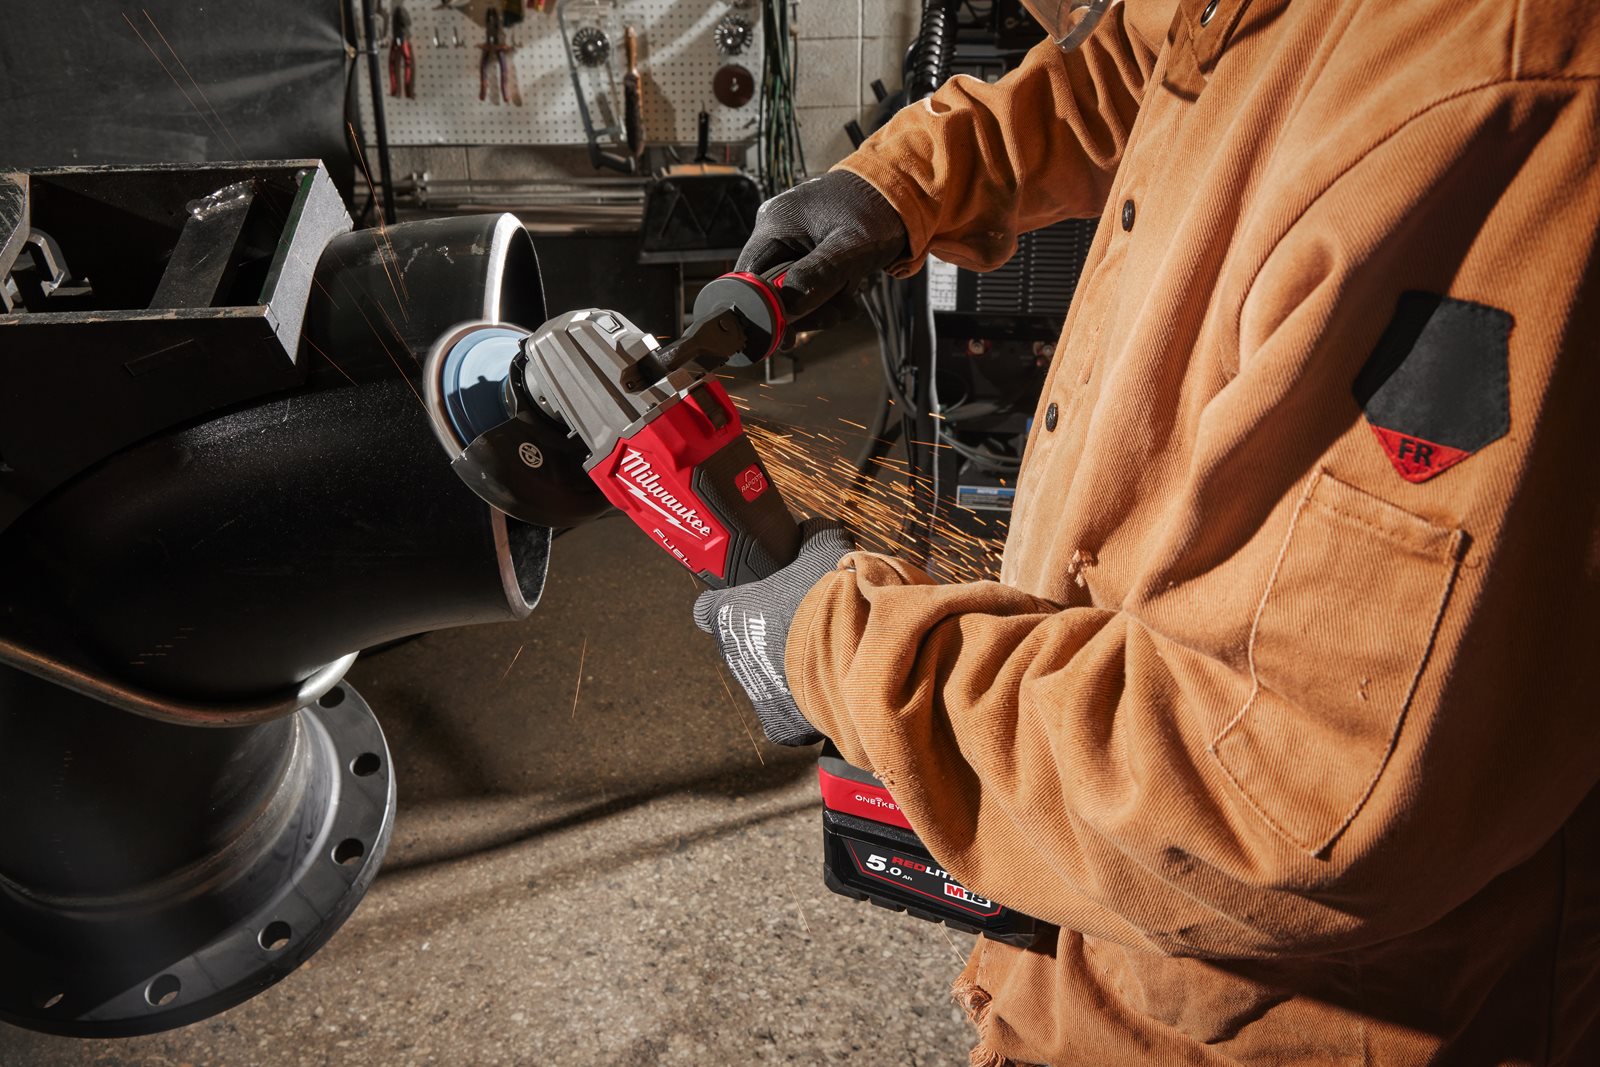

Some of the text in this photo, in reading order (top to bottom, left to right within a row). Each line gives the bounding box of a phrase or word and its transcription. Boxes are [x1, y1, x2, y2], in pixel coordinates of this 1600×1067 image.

[1399, 438, 1433, 467] FR
[621, 448, 711, 537] Milwaukee
[653, 528, 692, 568] FUEL
